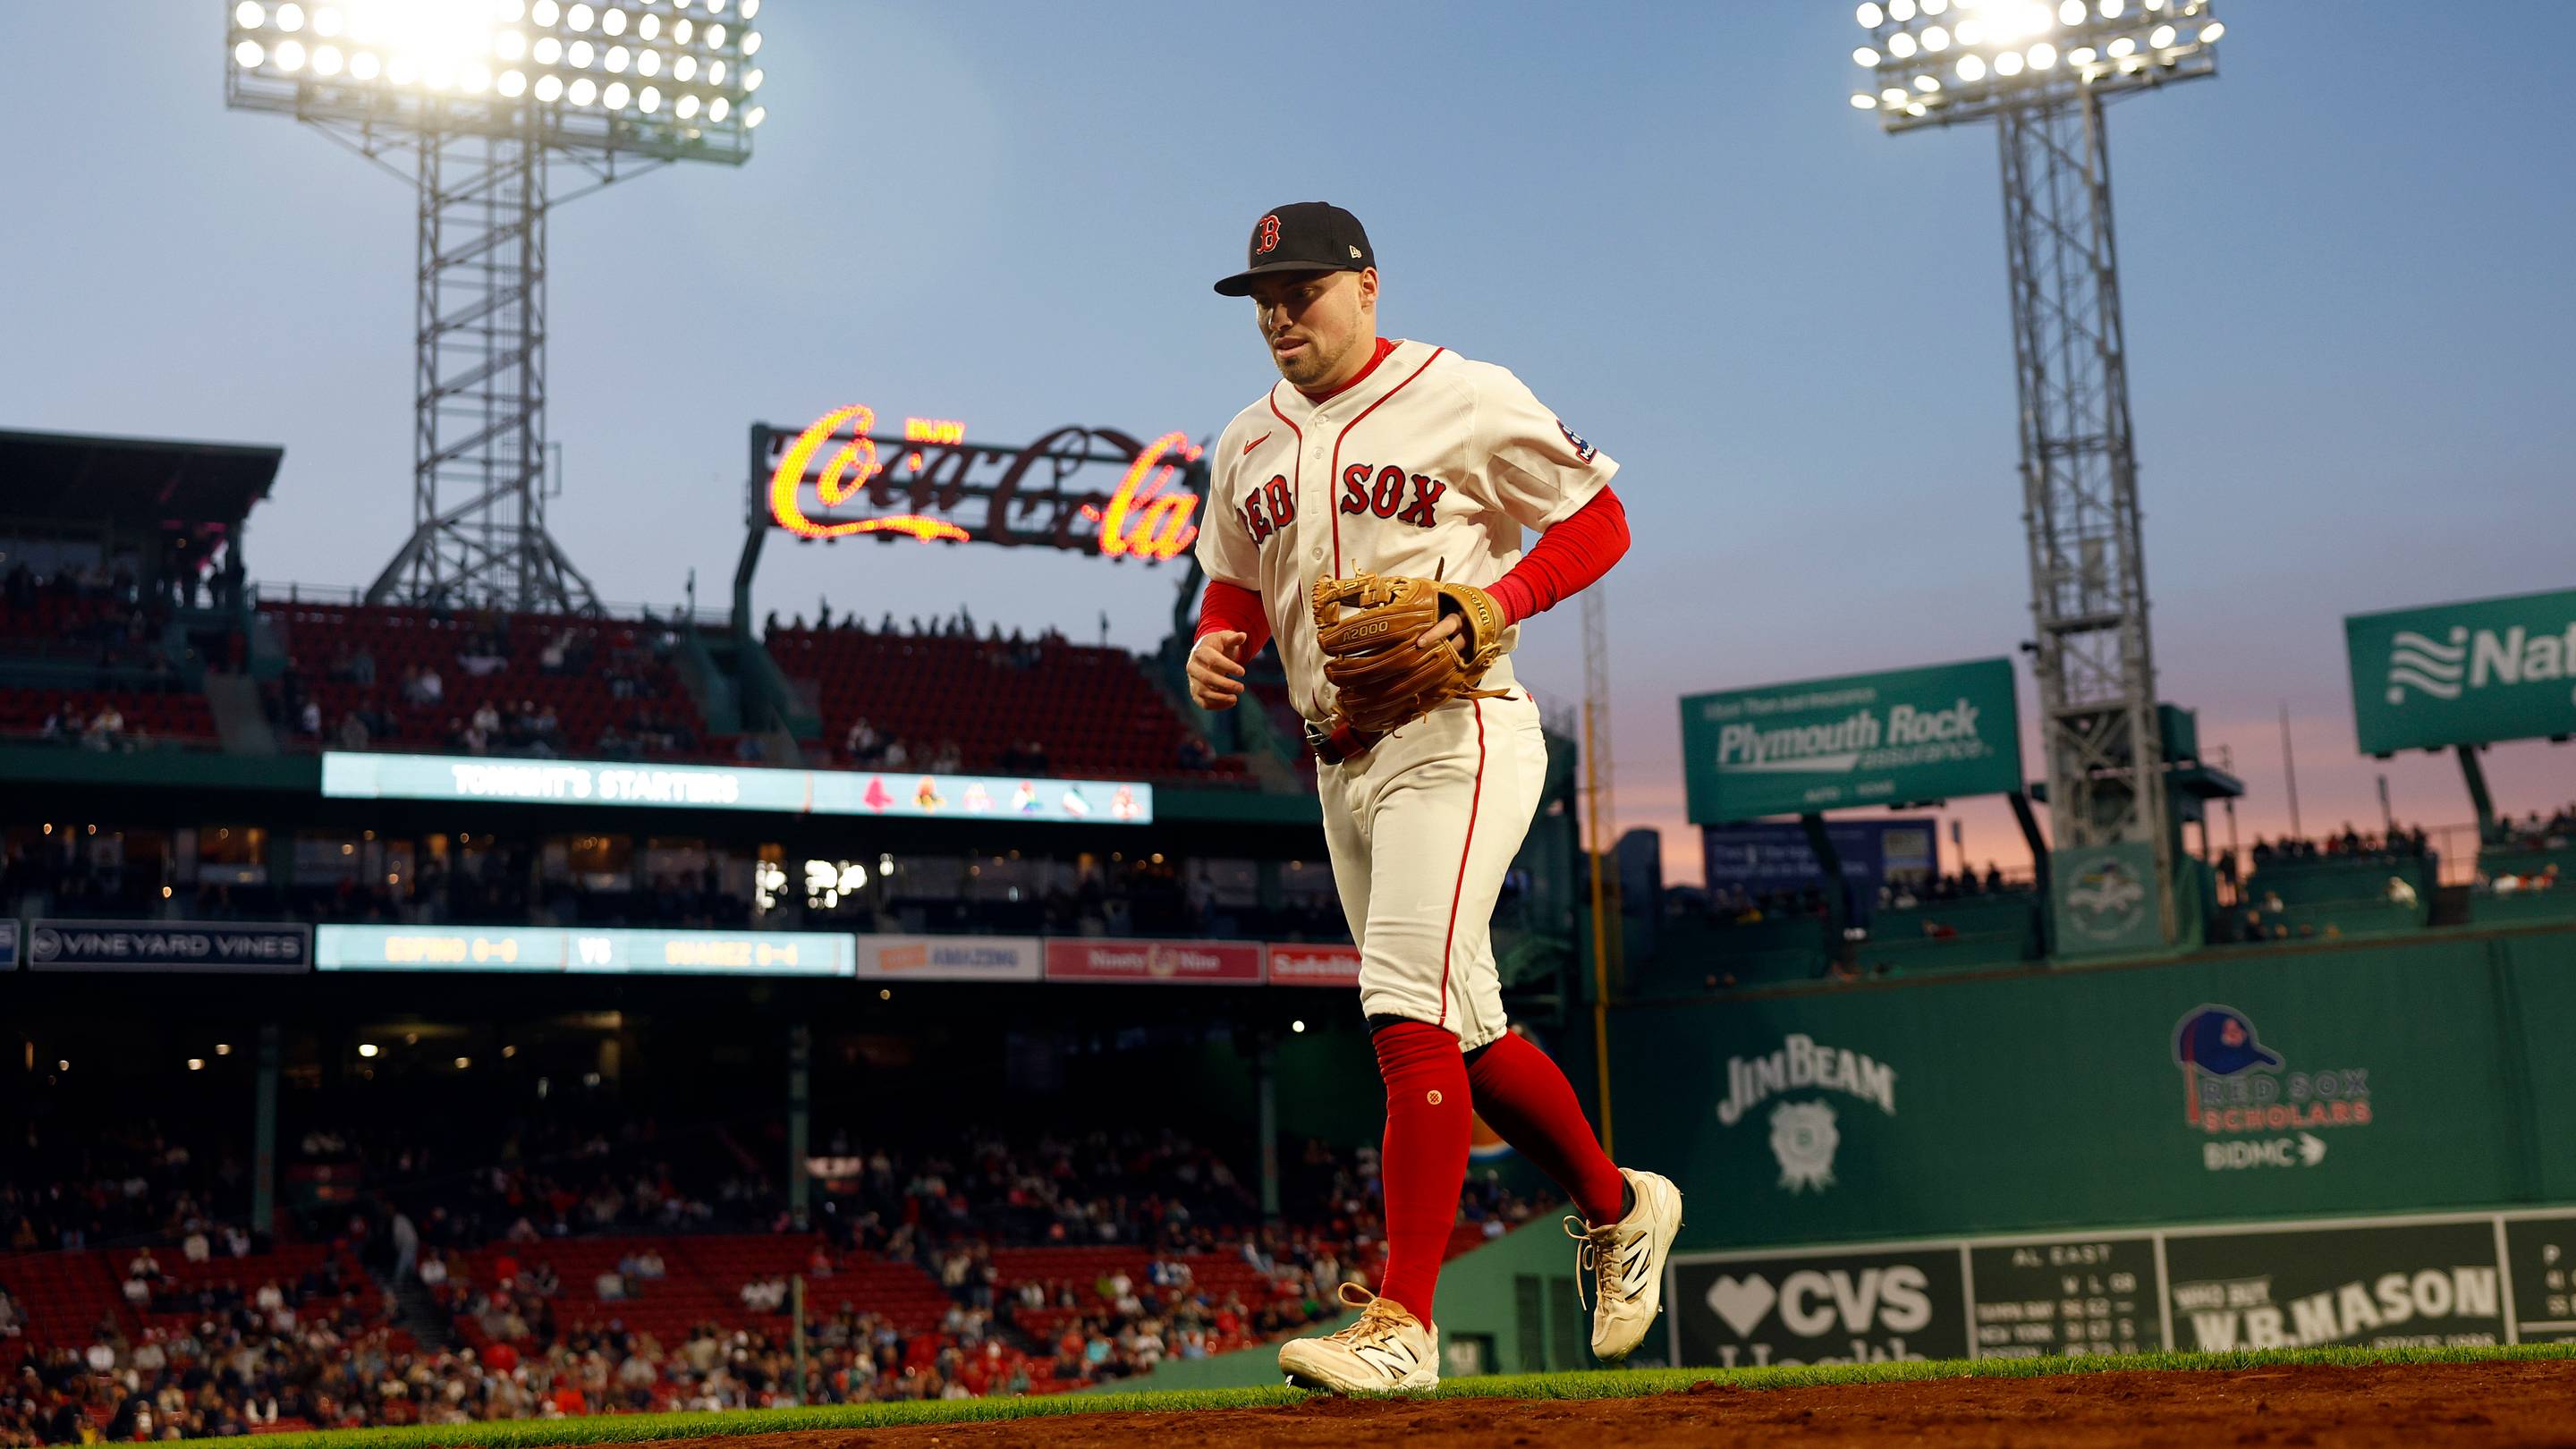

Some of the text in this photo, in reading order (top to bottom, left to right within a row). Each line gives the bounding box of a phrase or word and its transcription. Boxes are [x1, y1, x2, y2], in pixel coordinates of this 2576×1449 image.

[1256, 215, 1281, 255] B
[904, 418, 965, 445] ENJOY
[1340, 463, 1446, 529] SOX
[1343, 621, 1388, 643] A2000
[1716, 698, 1979, 767] Plymouth Rock
[452, 764, 739, 803] TONIGHT'S STARTERS
[63, 933, 301, 958] VINEYARD VINES
[578, 937, 612, 964] VS
[1786, 1033, 1897, 1115] BEAM
[2200, 1070, 2368, 1105] RED SOX
[2202, 1101, 2371, 1132] SCHOLARS
[2203, 1138, 2296, 1170] BIDMC
[2012, 1243, 2113, 1267] AL EAST
[1778, 1265, 1932, 1337] CVS
